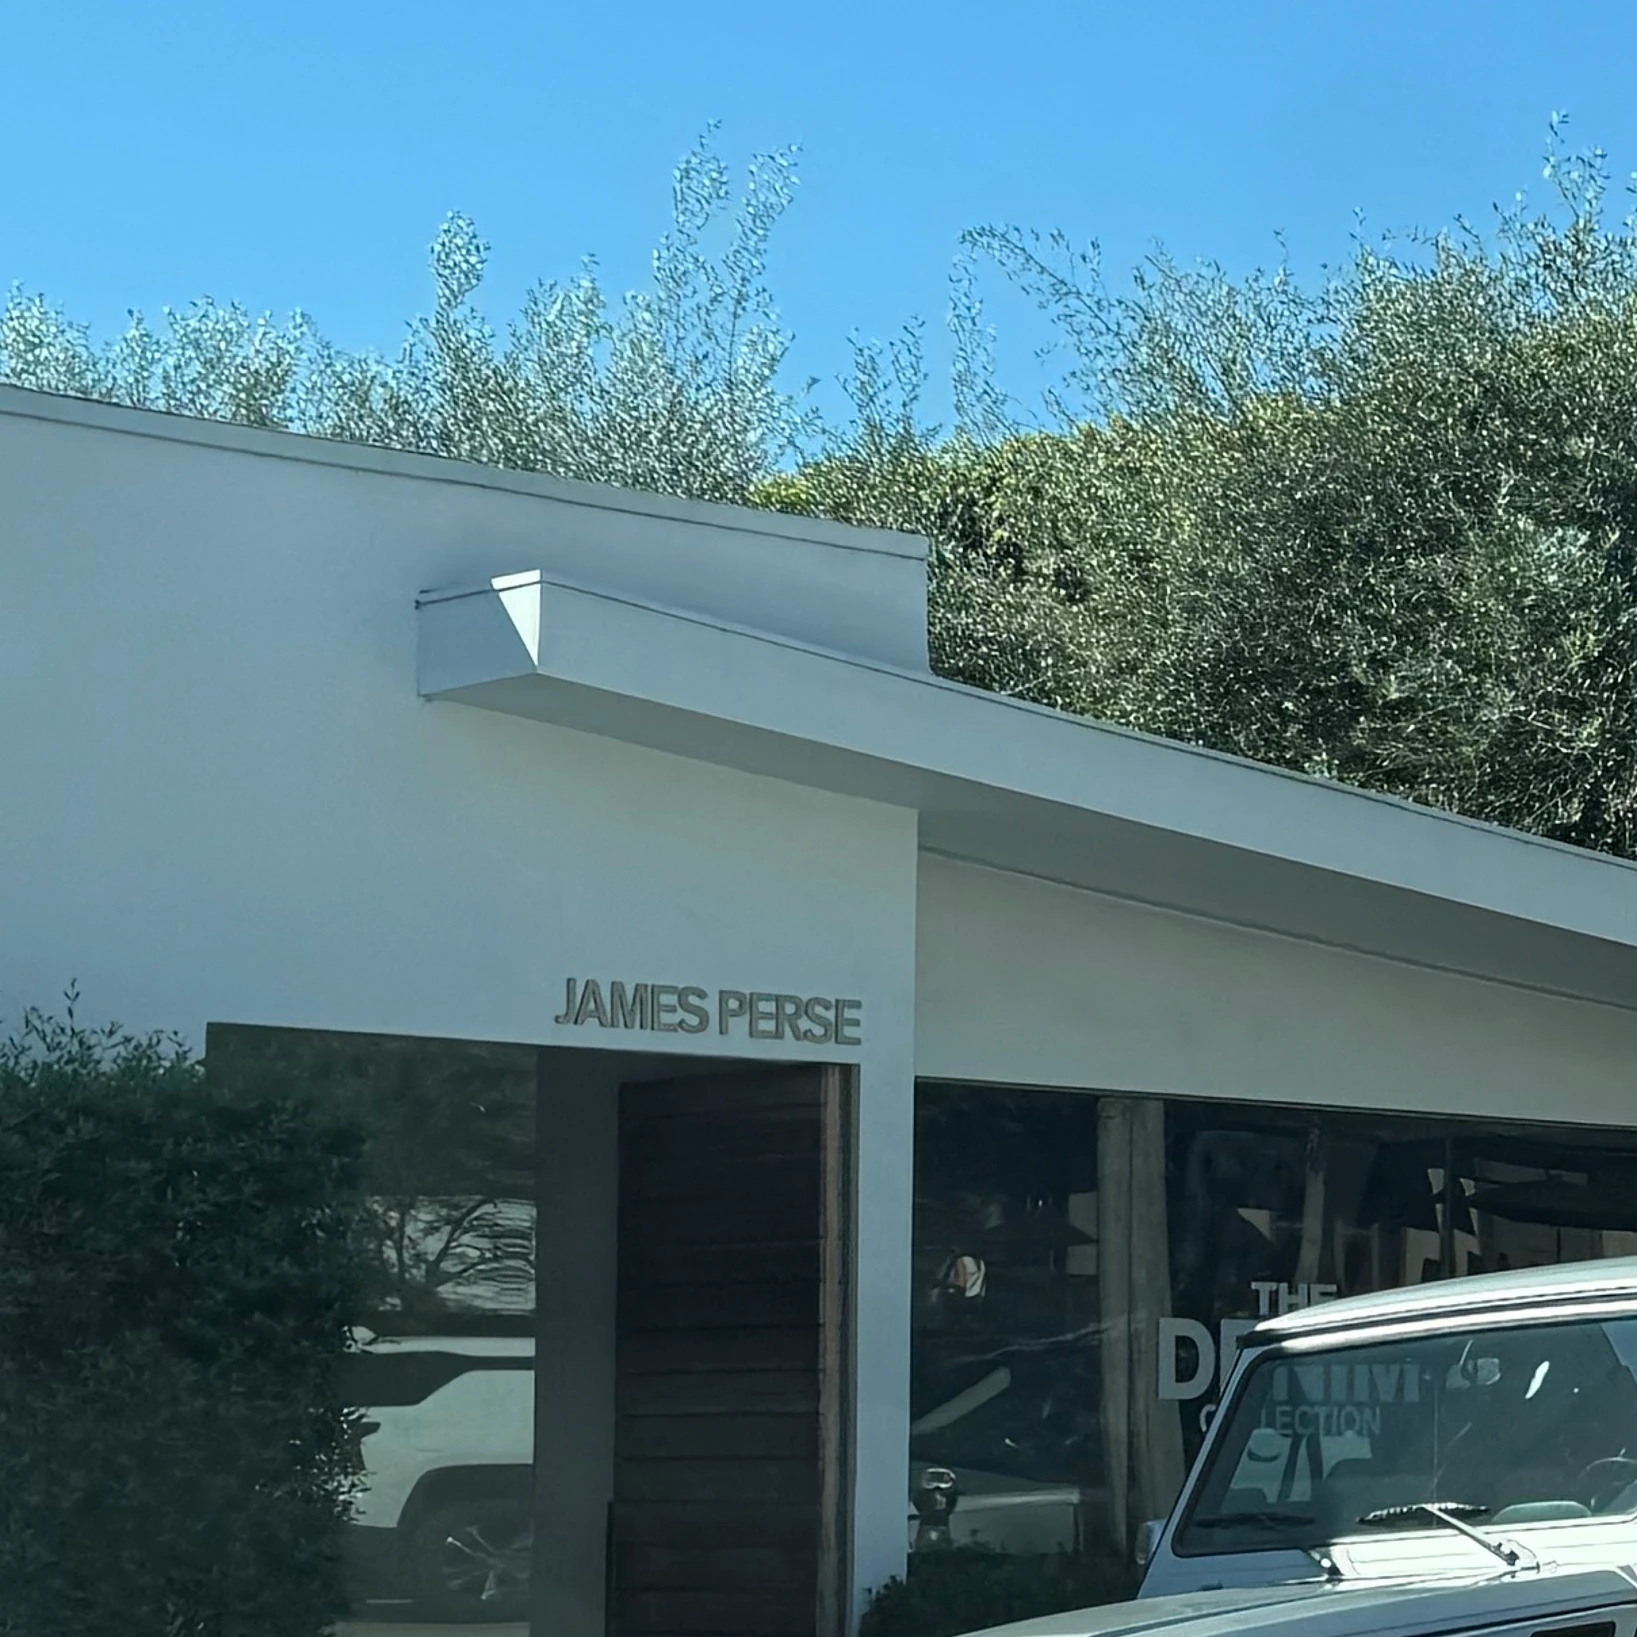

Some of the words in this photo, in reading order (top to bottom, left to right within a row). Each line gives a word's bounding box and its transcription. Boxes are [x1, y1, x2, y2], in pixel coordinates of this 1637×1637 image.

[554, 977, 709, 1034] JAMES
[718, 989, 863, 1046] PERSE
[1251, 1281, 1338, 1317] THE
